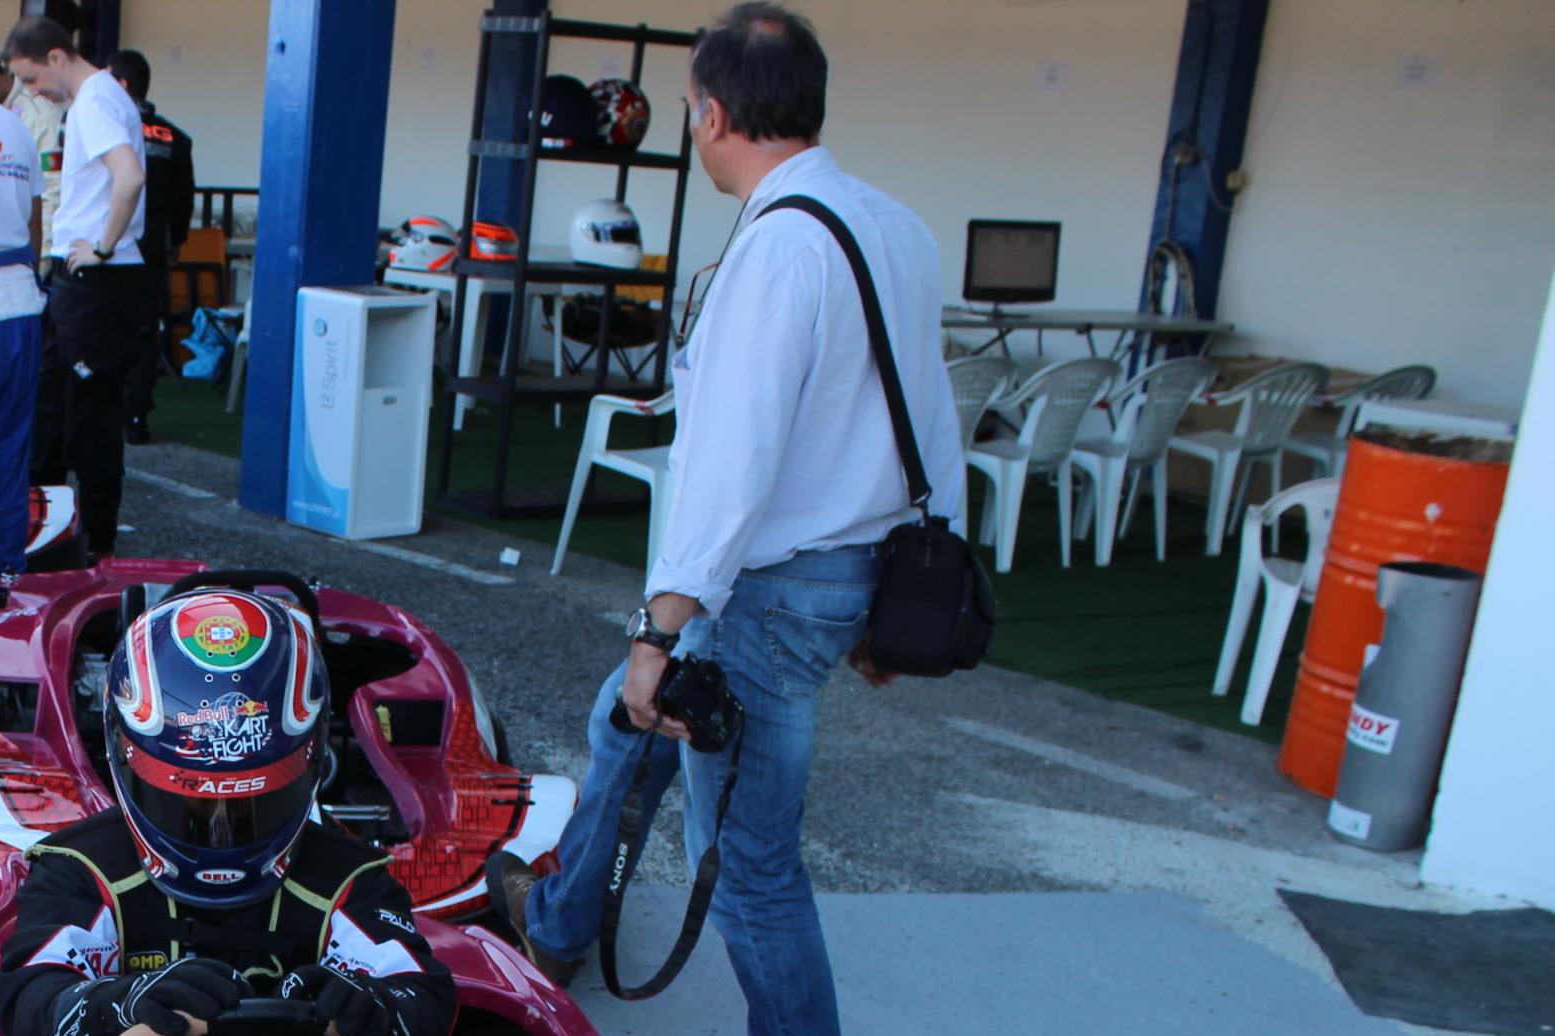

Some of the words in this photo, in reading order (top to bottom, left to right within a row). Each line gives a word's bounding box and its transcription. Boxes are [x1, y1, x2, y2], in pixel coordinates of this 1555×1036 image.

[225, 715, 268, 737] KART
[213, 733, 263, 758] FIGHT
[608, 843, 629, 895] SONY
[129, 955, 165, 969] OMP
